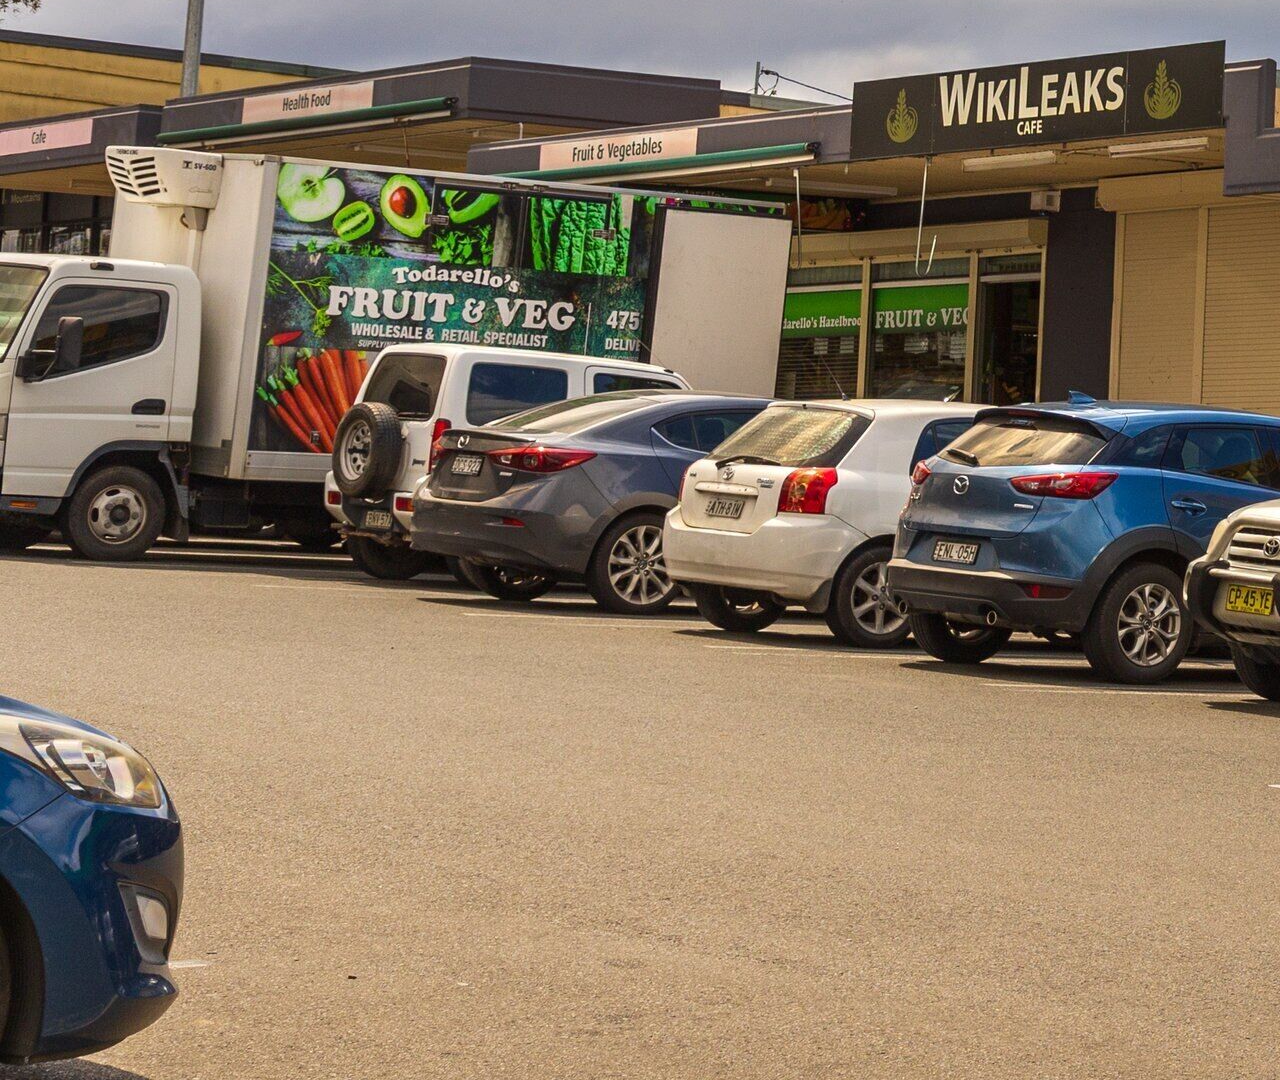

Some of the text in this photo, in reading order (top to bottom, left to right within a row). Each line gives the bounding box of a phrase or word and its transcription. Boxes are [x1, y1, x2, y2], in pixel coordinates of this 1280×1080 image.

[282, 93, 331, 112] Health Food
[1016, 119, 1043, 136] CAFE
[31, 131, 47, 145] Cafe
[572, 137, 663, 162] Fruit & Vegetables
[193, 164, 217, 172] SV-600
[392, 265, 520, 294] Todarello's
[326, 285, 576, 331] FRUIT & VEG
[875, 310, 924, 329] FRUIT
[927, 313, 938, 327] &
[351, 322, 548, 348] WHOLESALE & RETAIL SPECIALIST
